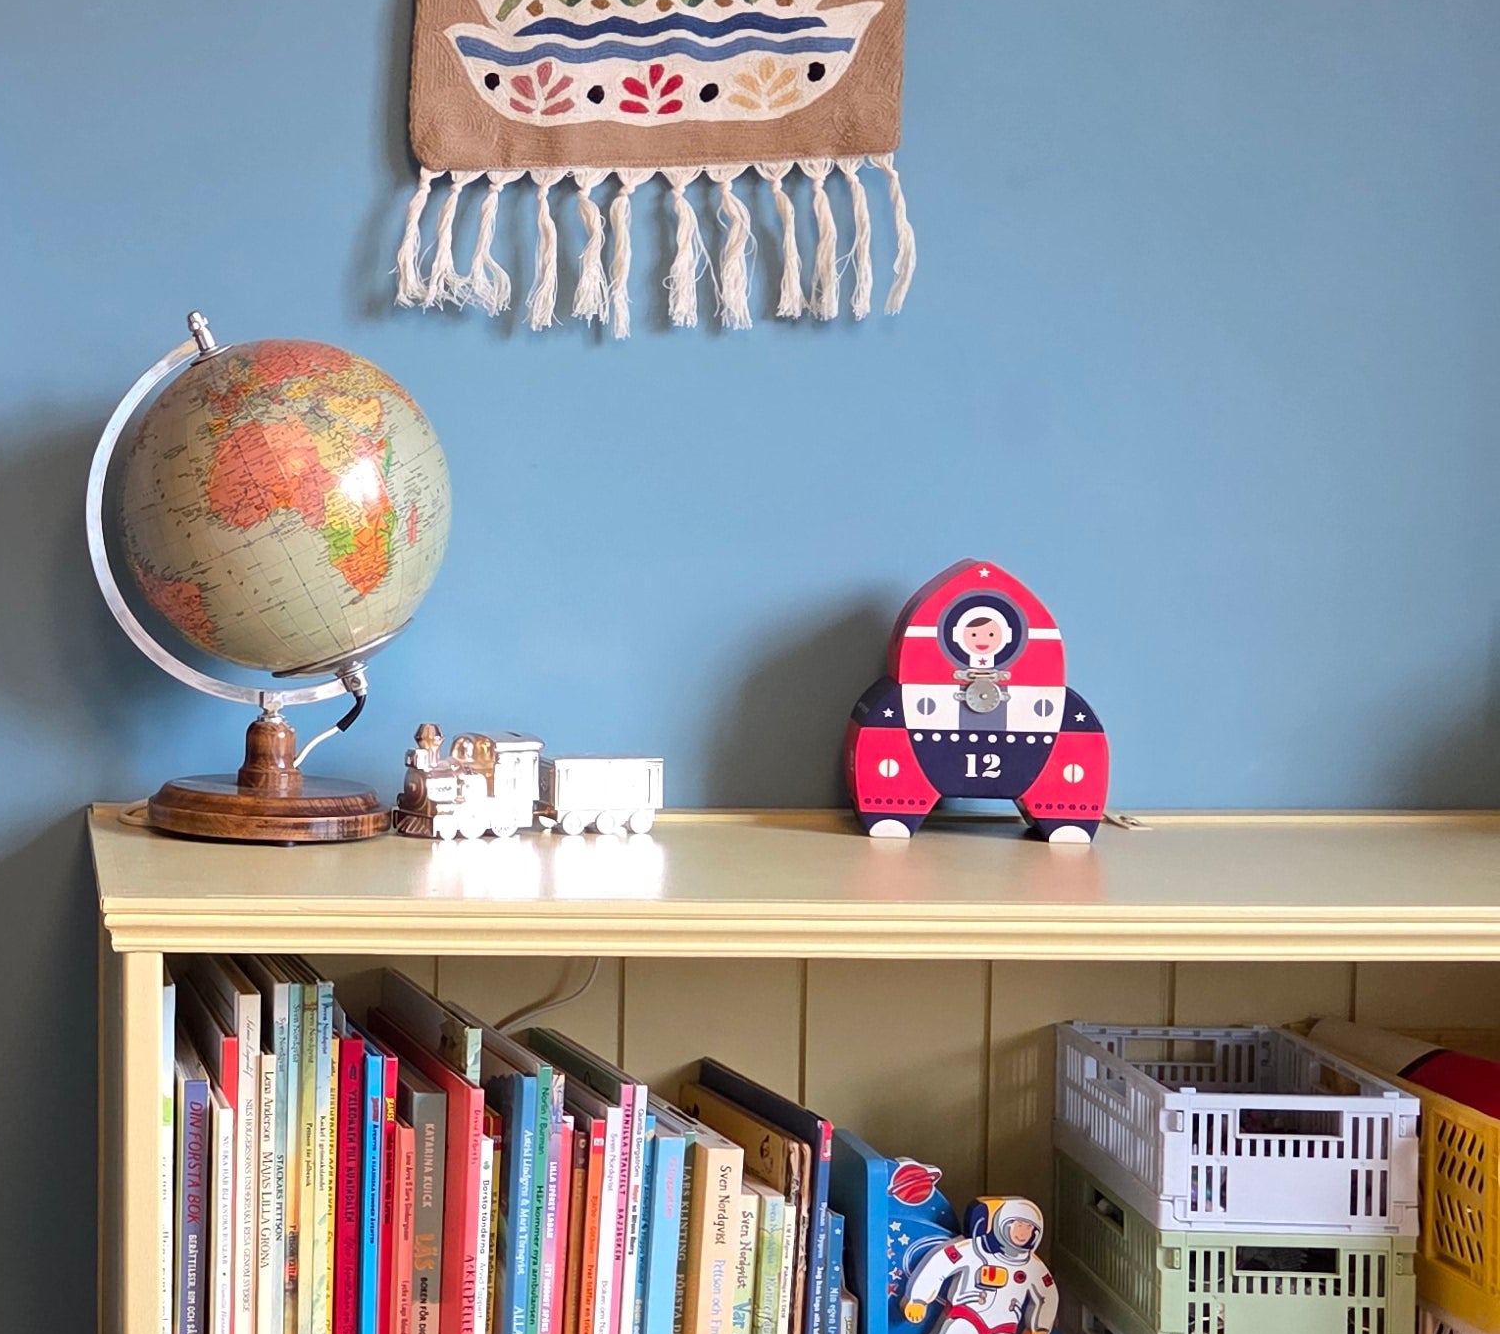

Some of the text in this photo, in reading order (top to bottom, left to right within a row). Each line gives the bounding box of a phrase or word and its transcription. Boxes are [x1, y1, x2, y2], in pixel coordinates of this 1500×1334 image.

[965, 753, 1002, 779] 12
[276, 1017, 286, 1035] Sven
[276, 1037, 286, 1072] Nordqvist
[264, 1071, 273, 1094] Lena
[188, 1101, 203, 1127] DIN
[263, 1097, 273, 1142] Anderson
[423, 1123, 436, 1173] KATARINA
[523, 1130, 534, 1157] Astrid
[609, 1133, 618, 1153] Sven
[632, 1108, 645, 1178] Gunilla Bergström
[276, 1155, 285, 1199] STACKARS
[519, 1158, 532, 1197] Lindgren
[549, 1161, 558, 1182] LILLA
[607, 1154, 617, 1192] Nordqvist
[614, 1103, 632, 1261] PERNILLA STALFELT BAJSBOKEN
[682, 1165, 692, 1196] LARS
[718, 1165, 732, 1191] Sven
[422, 1175, 433, 1208] KUICK
[529, 1086, 550, 1325] Norlin Burman Här kommer nya ambulansen
[187, 1193, 202, 1224] BOK
[261, 1191, 273, 1224] LILLA
[275, 1201, 284, 1241] PETTSON
[480, 1179, 490, 1254] Borsta tänderna
[518, 1208, 529, 1233] Marit
[713, 1194, 730, 1245] Nordqvist
[546, 1212, 554, 1239] LABAN
[677, 1201, 690, 1262] KLINTING
[740, 1210, 755, 1238] Sven
[414, 1233, 439, 1271] LÄS
[735, 1240, 752, 1289] Nordqvist
[242, 1248, 251, 1313] GENOM SVERIGE
[712, 1259, 726, 1295] Pettson
[814, 1266, 824, 1279] Jag
[418, 1276, 428, 1304] BOKEN
[600, 1280, 609, 1305] Boken
[674, 1273, 685, 1319] FÖRSTA
[828, 1286, 839, 1303] Min
[186, 1305, 197, 1322] OCH
[418, 1305, 430, 1321] FÖR
[711, 1297, 724, 1316] och
[731, 1298, 753, 1328] Var
[826, 1304, 836, 1324] egen
